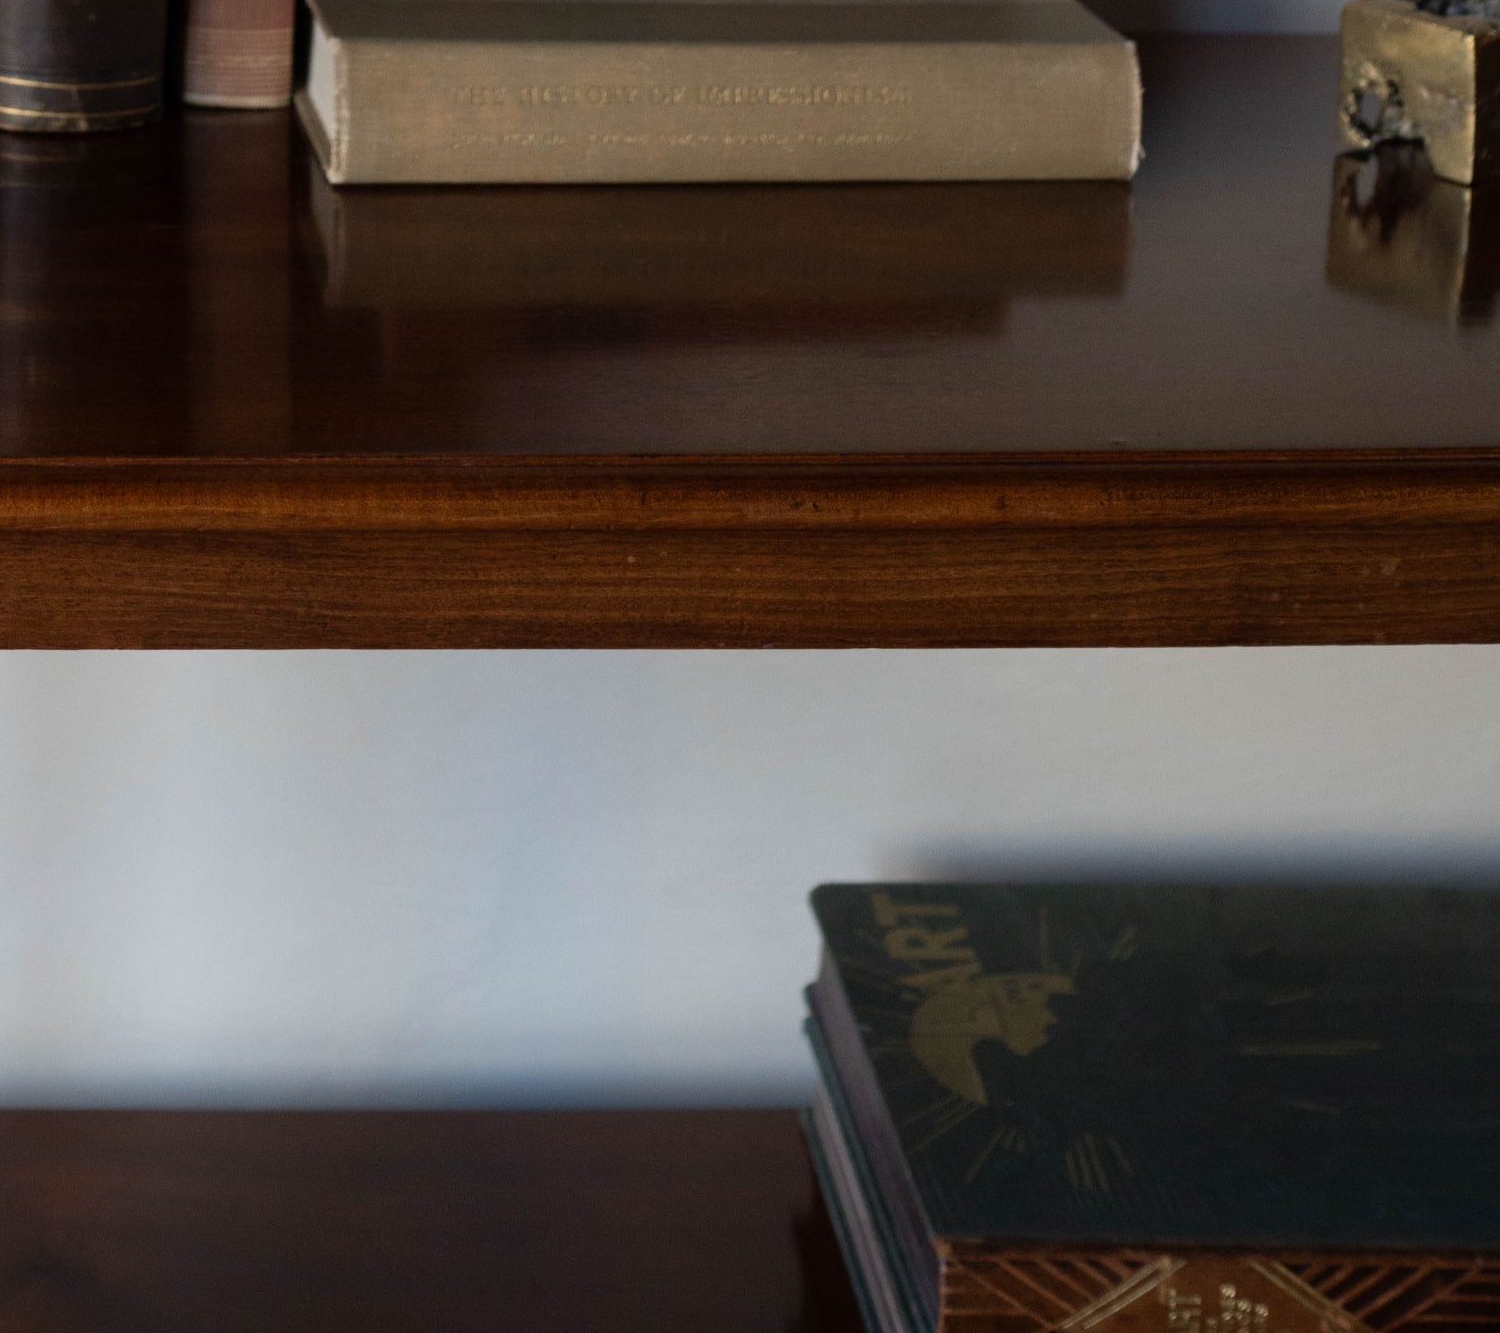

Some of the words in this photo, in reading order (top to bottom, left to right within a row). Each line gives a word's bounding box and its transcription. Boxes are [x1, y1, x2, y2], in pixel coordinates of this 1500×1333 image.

[518, 85, 638, 106] HISTORY
[649, 85, 688, 106] OF
[699, 85, 913, 106] IMPRESSIONISM
